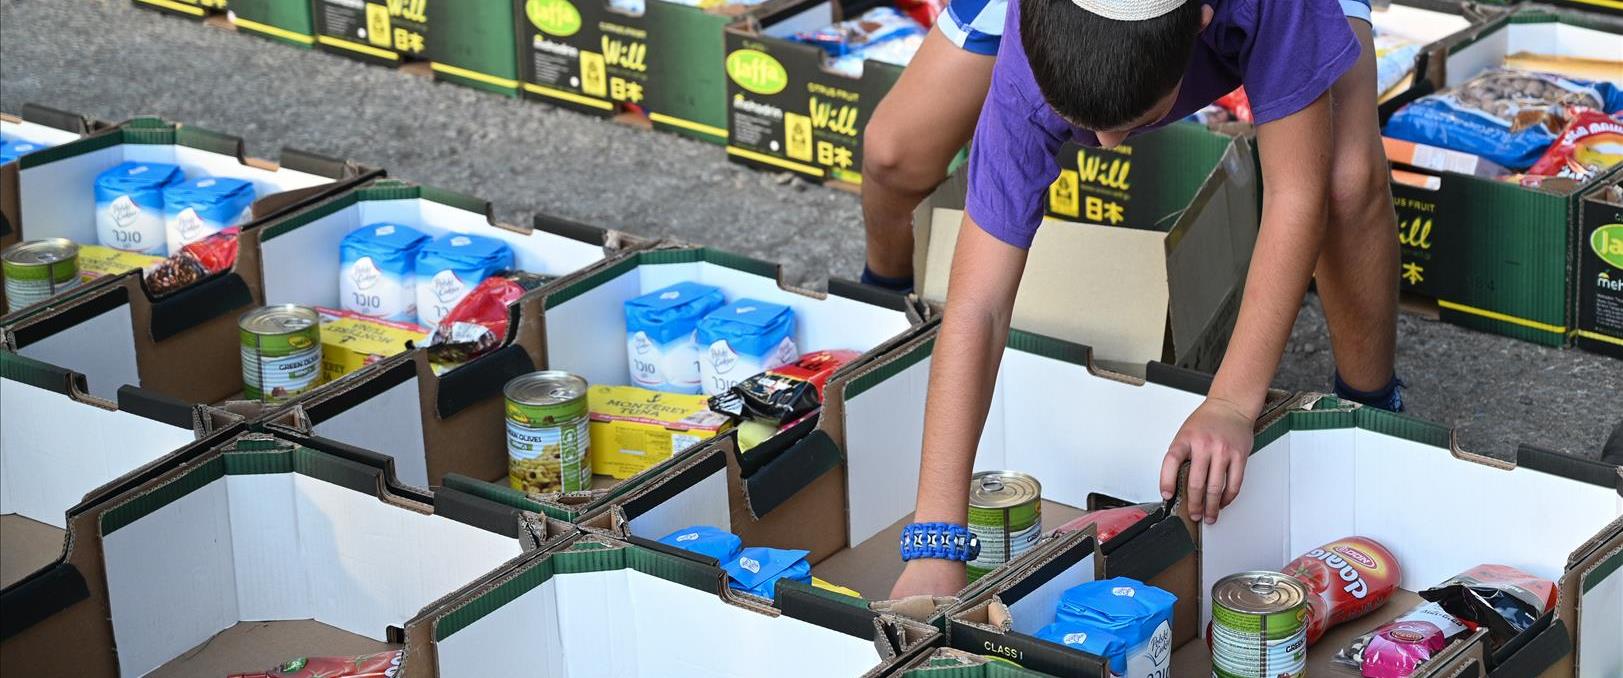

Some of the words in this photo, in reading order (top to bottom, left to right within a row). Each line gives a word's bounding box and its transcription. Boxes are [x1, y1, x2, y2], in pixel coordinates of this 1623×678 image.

[601, 35, 647, 71] Will
[733, 56, 779, 84] Jaffa
[610, 77, 643, 103] 日本
[809, 97, 857, 136] Will
[817, 141, 853, 168] 日本
[1077, 149, 1130, 190] Will
[1085, 195, 1124, 224] 日本
[1392, 196, 1406, 207] US
[1409, 200, 1436, 212] FRUIT
[112, 229, 141, 243] סוכר
[1399, 217, 1432, 249] ill
[1601, 230, 1623, 255] Ja
[1402, 262, 1424, 285] 本
[352, 292, 380, 308] סוכר
[633, 359, 656, 374] סוכר
[607, 399, 689, 415] MONTEREY
[620, 408, 659, 417] TUNA
[519, 434, 542, 443] OLIVES
[984, 641, 1017, 659] CLASS
